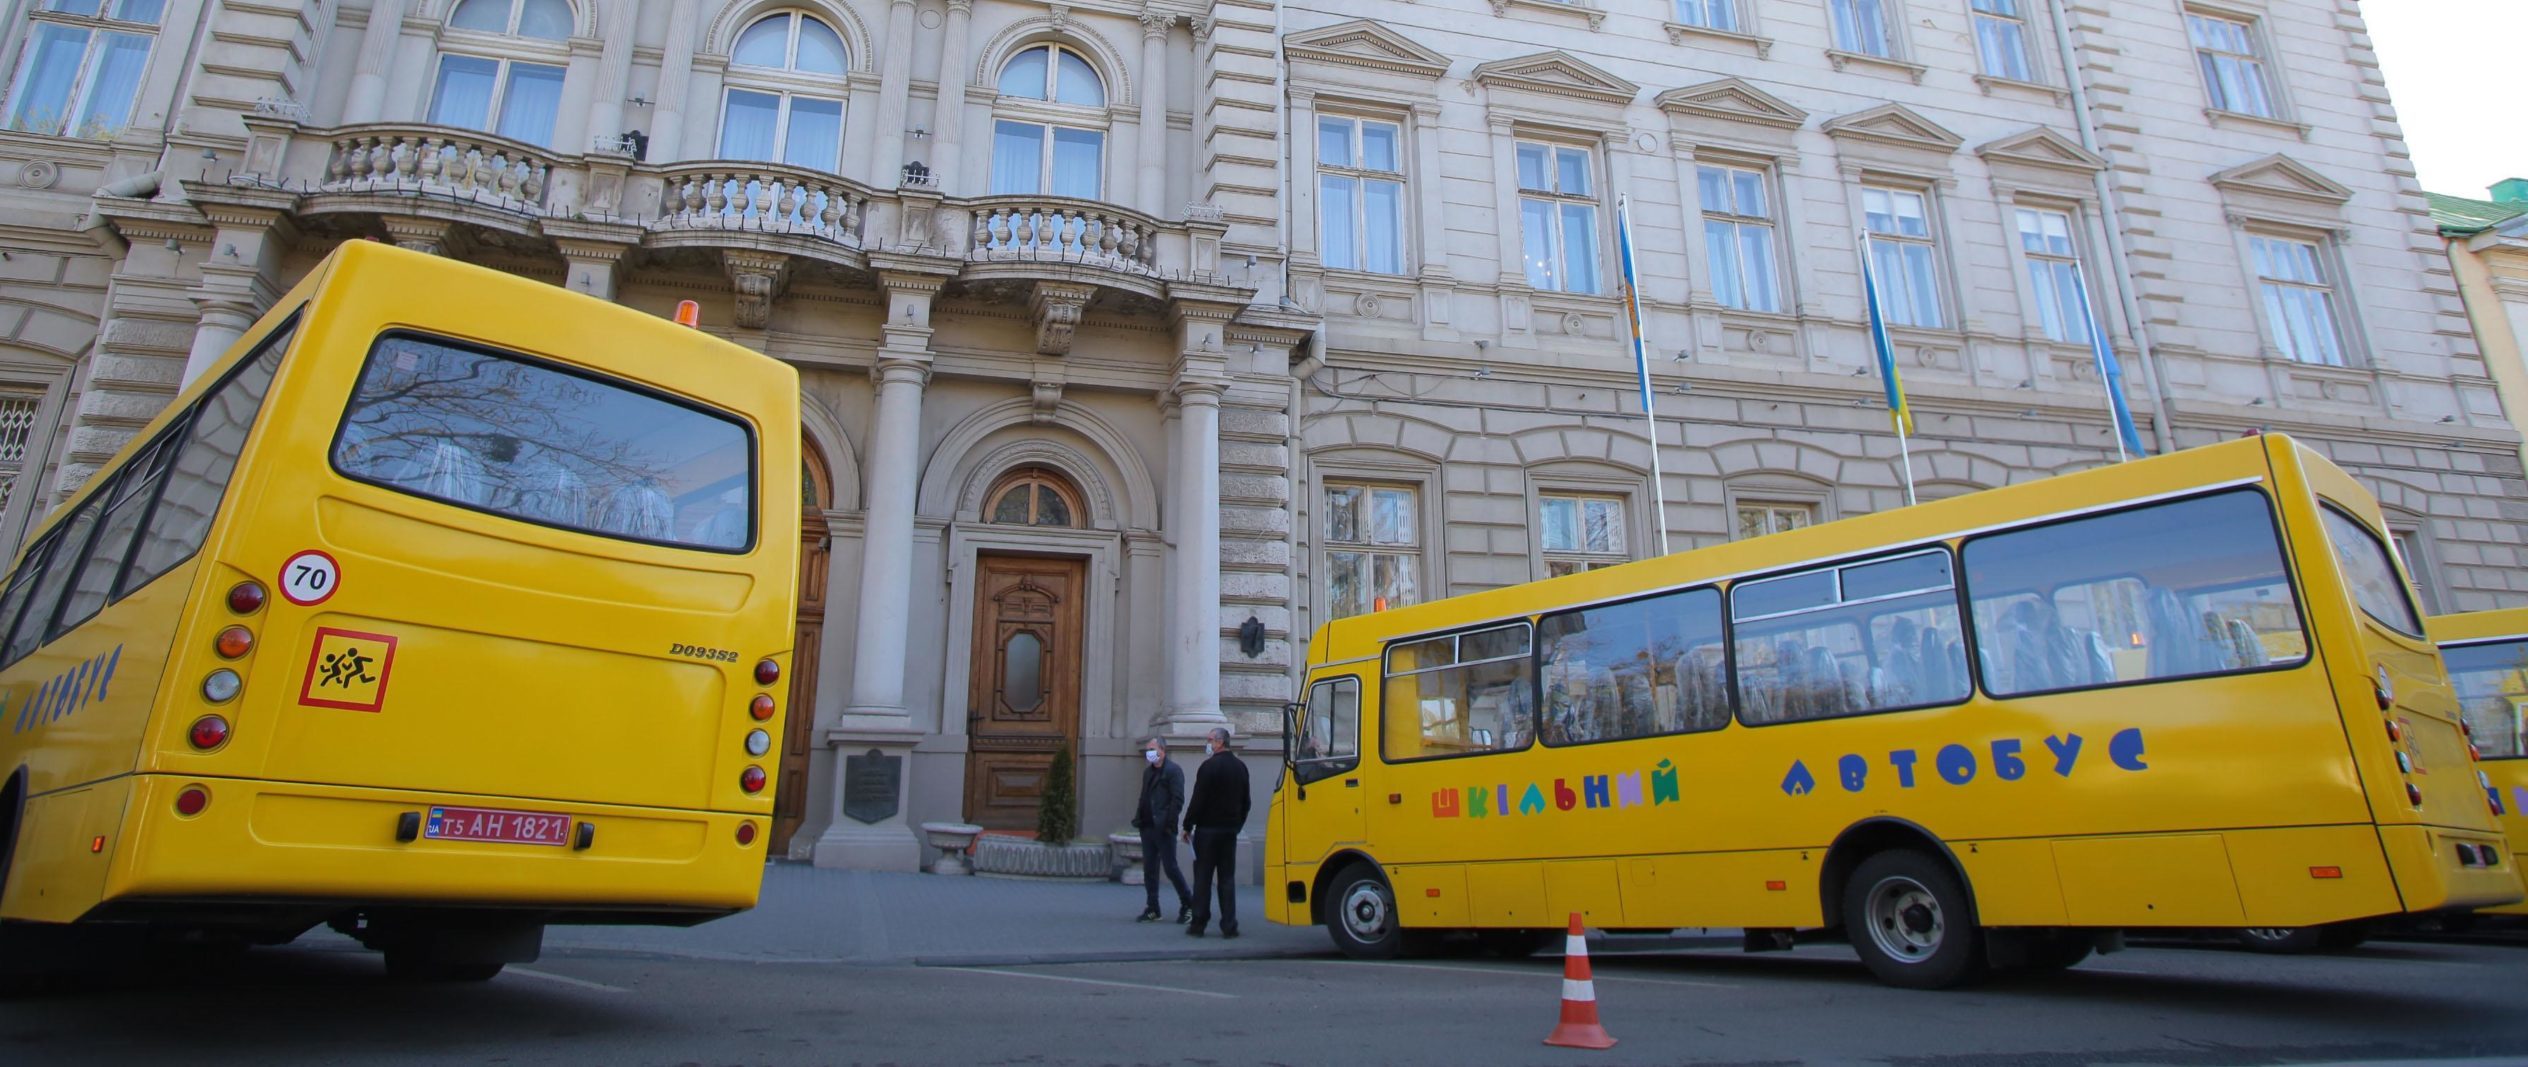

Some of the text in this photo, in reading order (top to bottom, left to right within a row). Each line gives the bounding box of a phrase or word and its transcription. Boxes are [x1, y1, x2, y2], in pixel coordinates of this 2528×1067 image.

[294, 565, 327, 590] 70
[1432, 728, 2148, 818] ШКІЛЬНИЙ АВТОБУС
[512, 816, 562, 840] 1821
